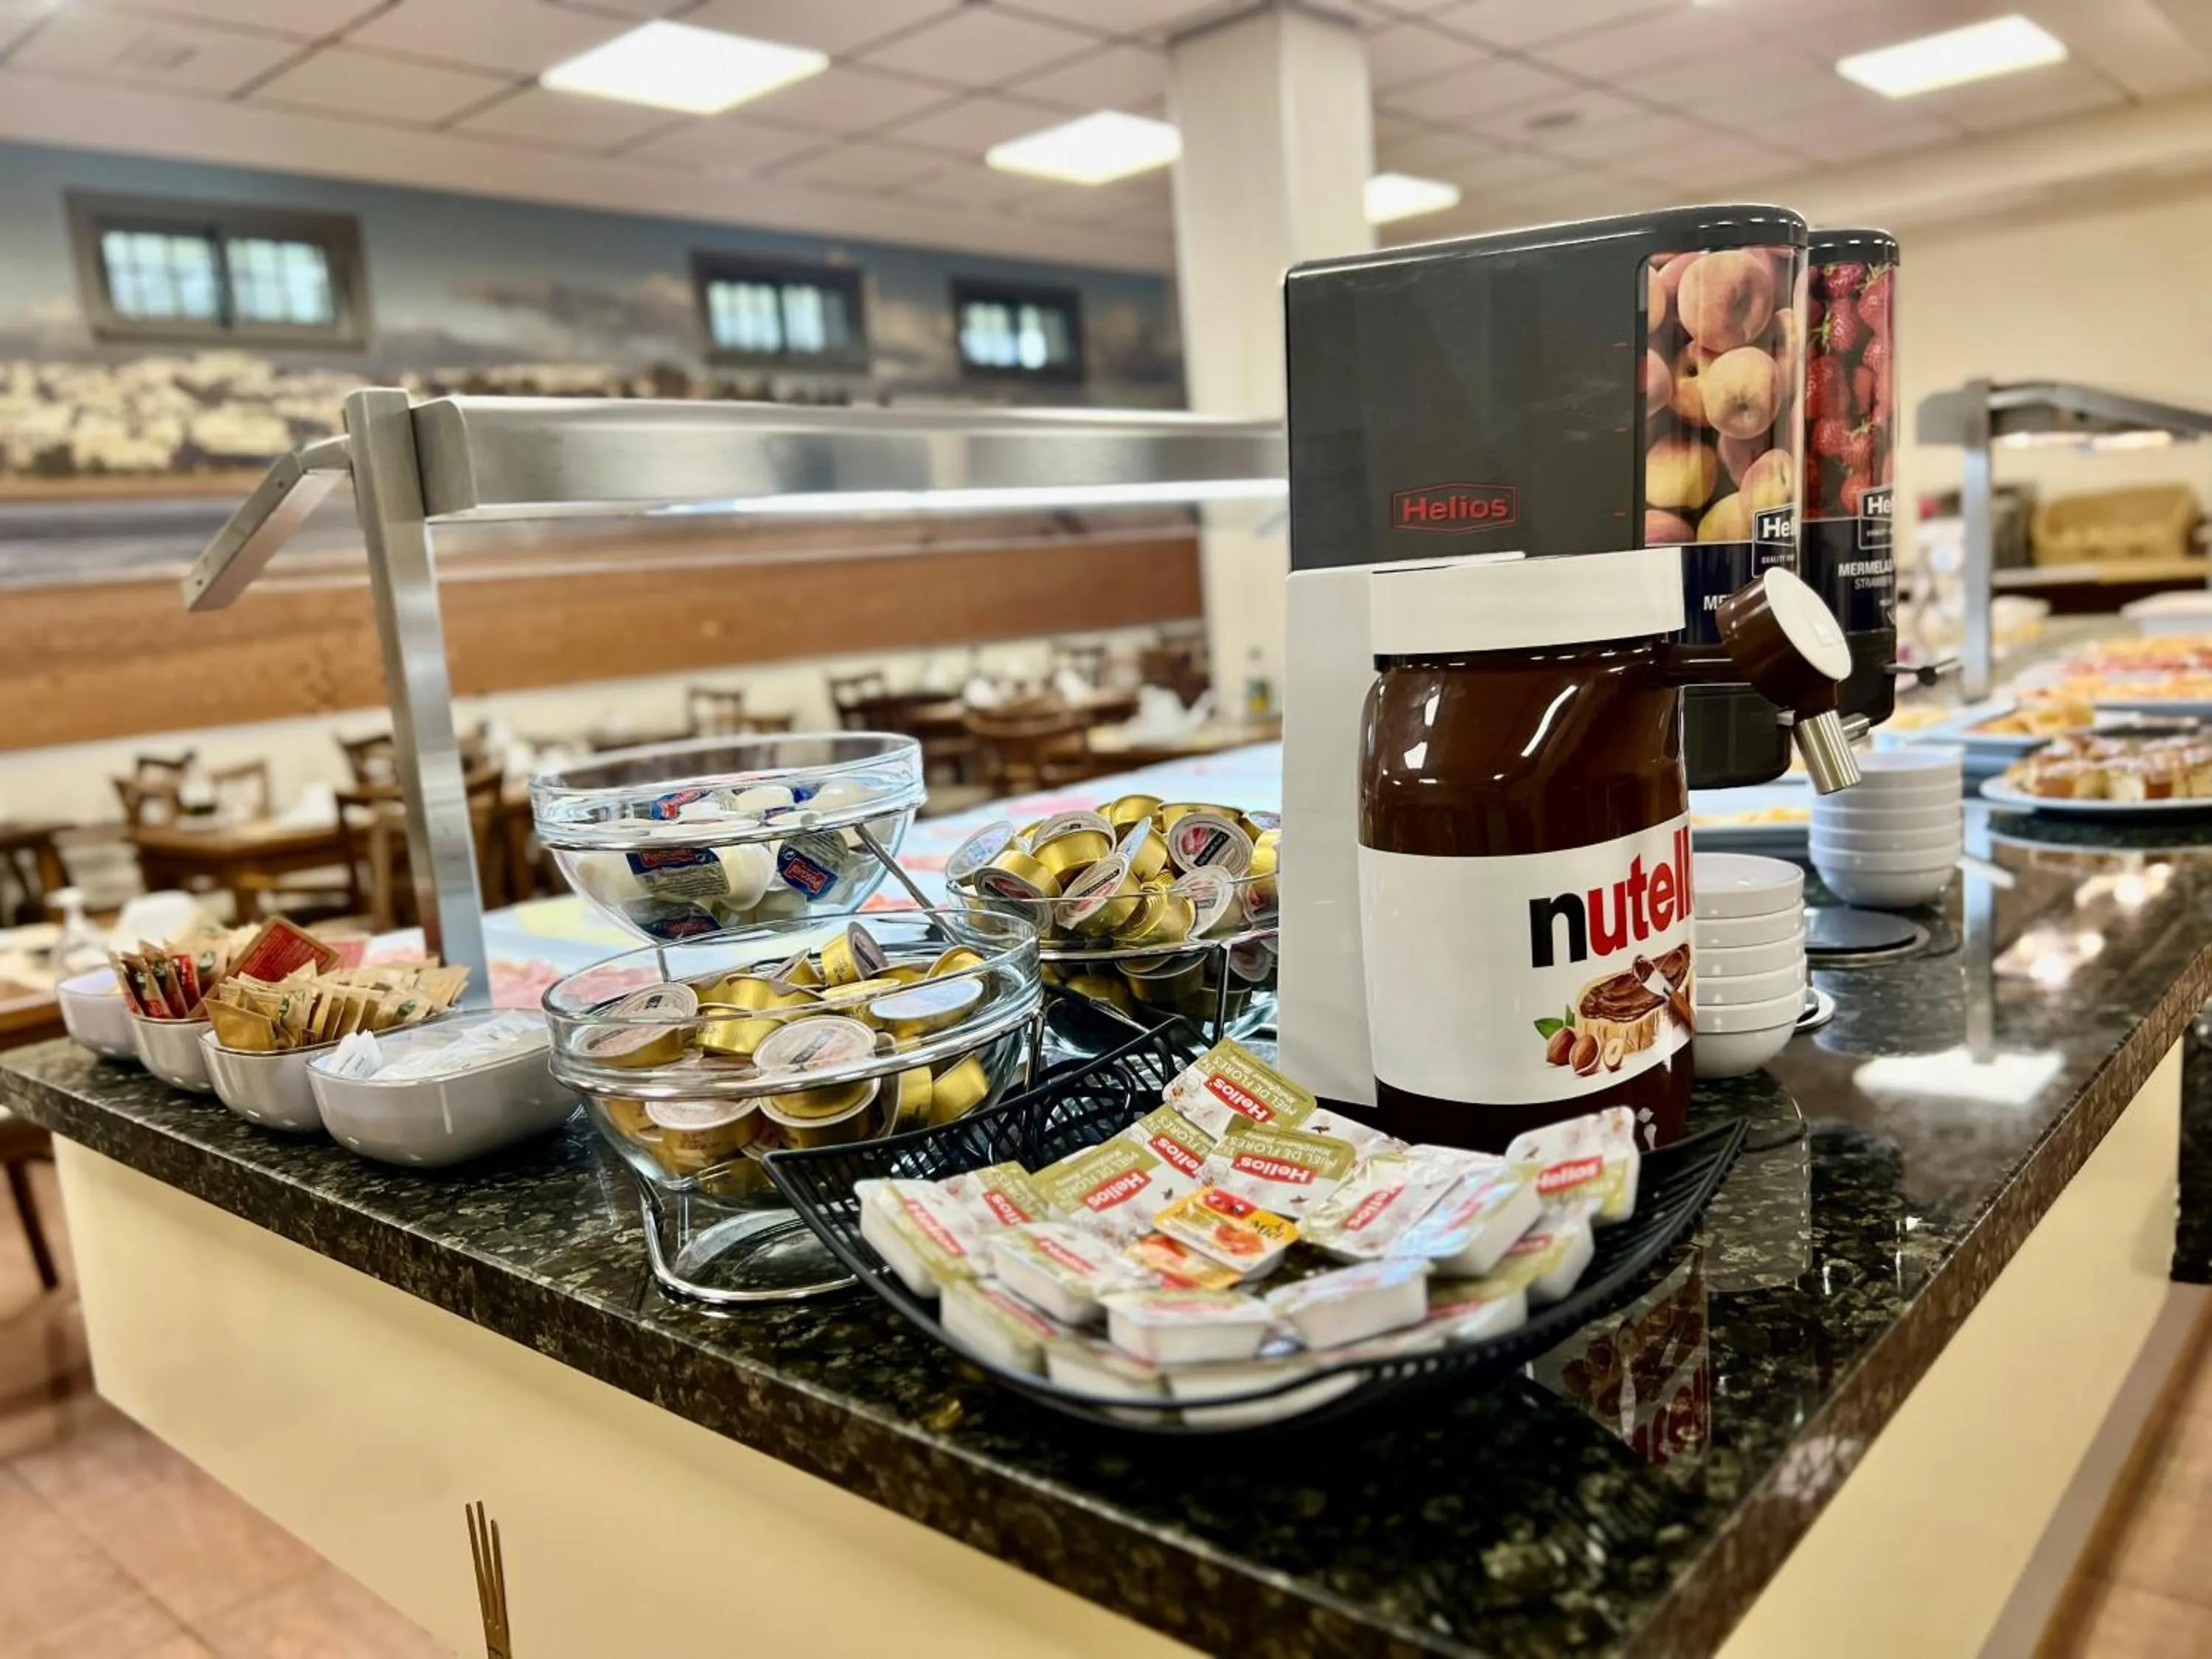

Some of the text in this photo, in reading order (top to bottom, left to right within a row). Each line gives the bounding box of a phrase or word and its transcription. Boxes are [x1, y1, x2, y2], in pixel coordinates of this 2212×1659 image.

[1403, 495, 1509, 523] Helios
[1867, 495, 1893, 515] He
[1212, 1056, 1254, 1091] FLORES
[1213, 1077, 1268, 1119] Helios
[1254, 1083, 1270, 1099] DE
[1155, 1135, 1201, 1175] elios
[1230, 1137, 1281, 1157] FLORES
[1284, 1149, 1301, 1158] DE
[1239, 1156, 1310, 1182] Helios
[1087, 1171, 1145, 1208] Helios
